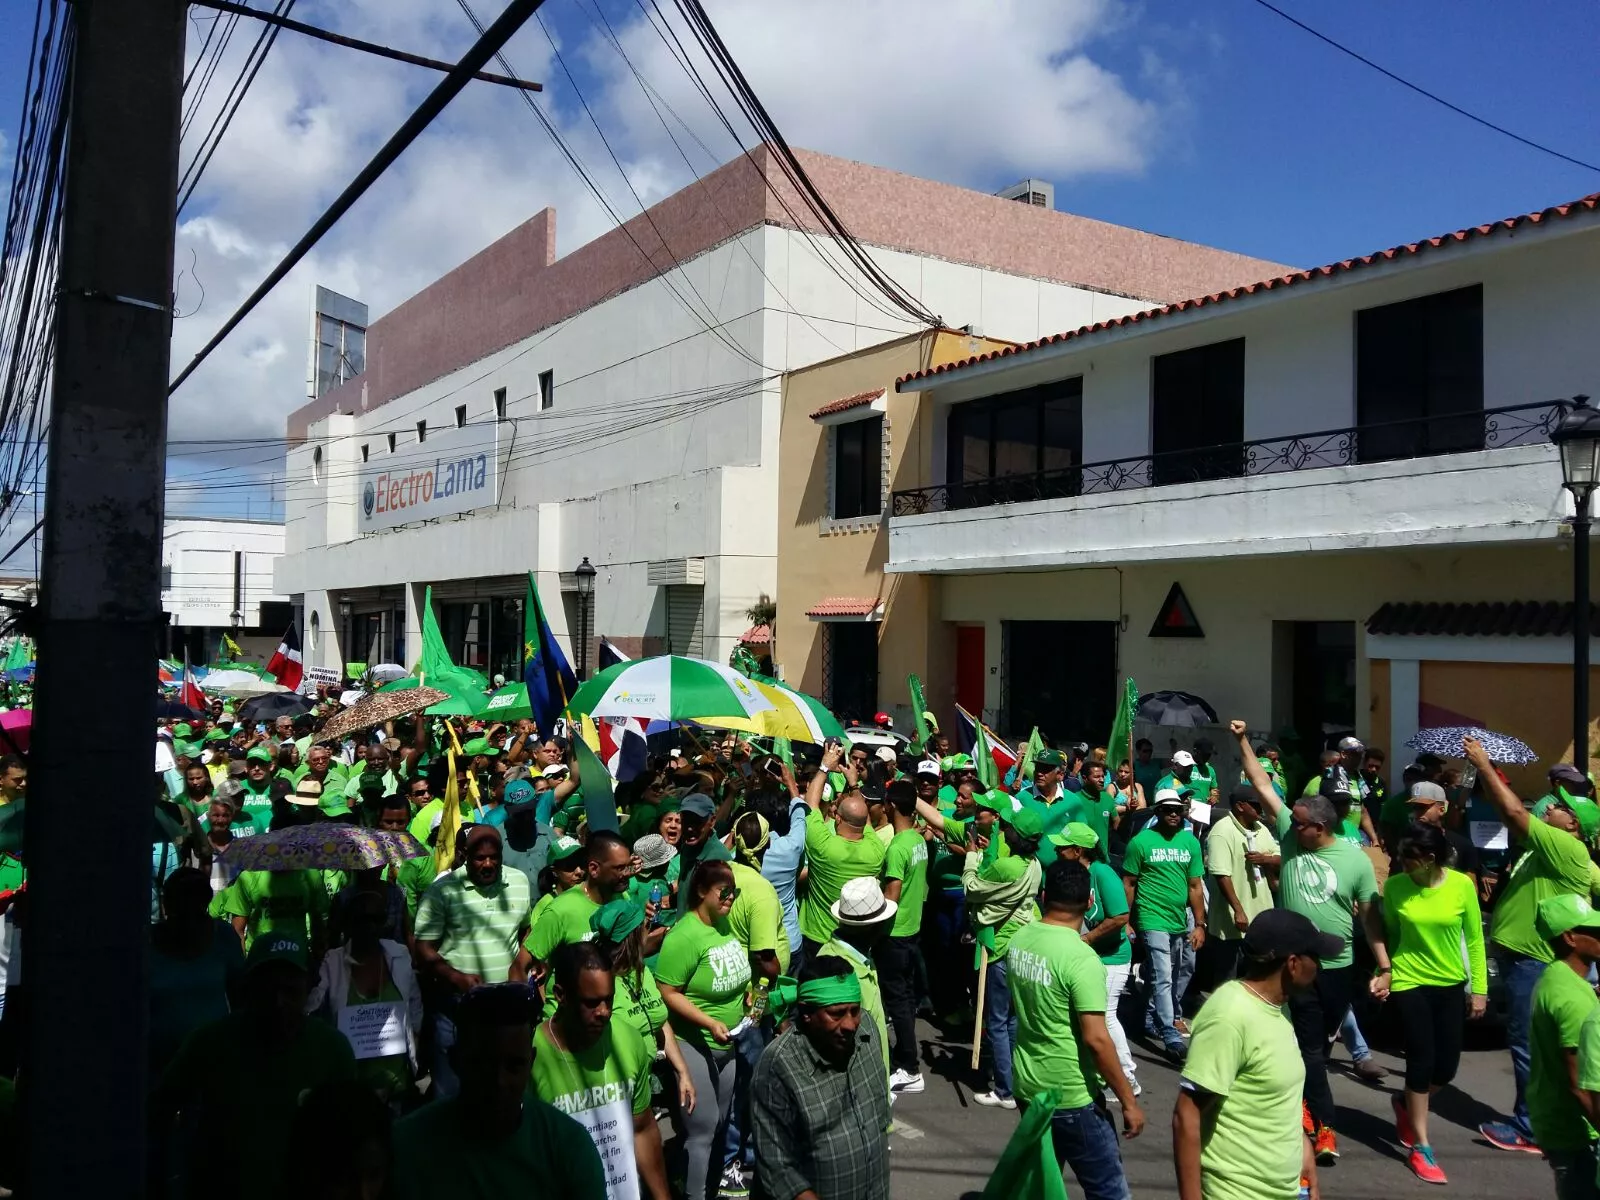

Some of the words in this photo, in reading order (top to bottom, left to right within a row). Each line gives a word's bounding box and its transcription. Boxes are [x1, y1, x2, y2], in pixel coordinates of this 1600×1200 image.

[375, 453, 487, 514] ElectroLama
[230, 826, 256, 838] TIAGO
[1152, 848, 1167, 856] FIN
[1168, 848, 1180, 856] DE
[1021, 950, 1034, 964] DE
[1034, 954, 1047, 968] LA
[1010, 959, 1052, 986] PUNIDAD
[594, 1135, 617, 1147] archa
[602, 1150, 609, 1160] el
[611, 1147, 621, 1157] fin
[608, 1164, 615, 1172] la
[605, 1173, 627, 1188] nidad
